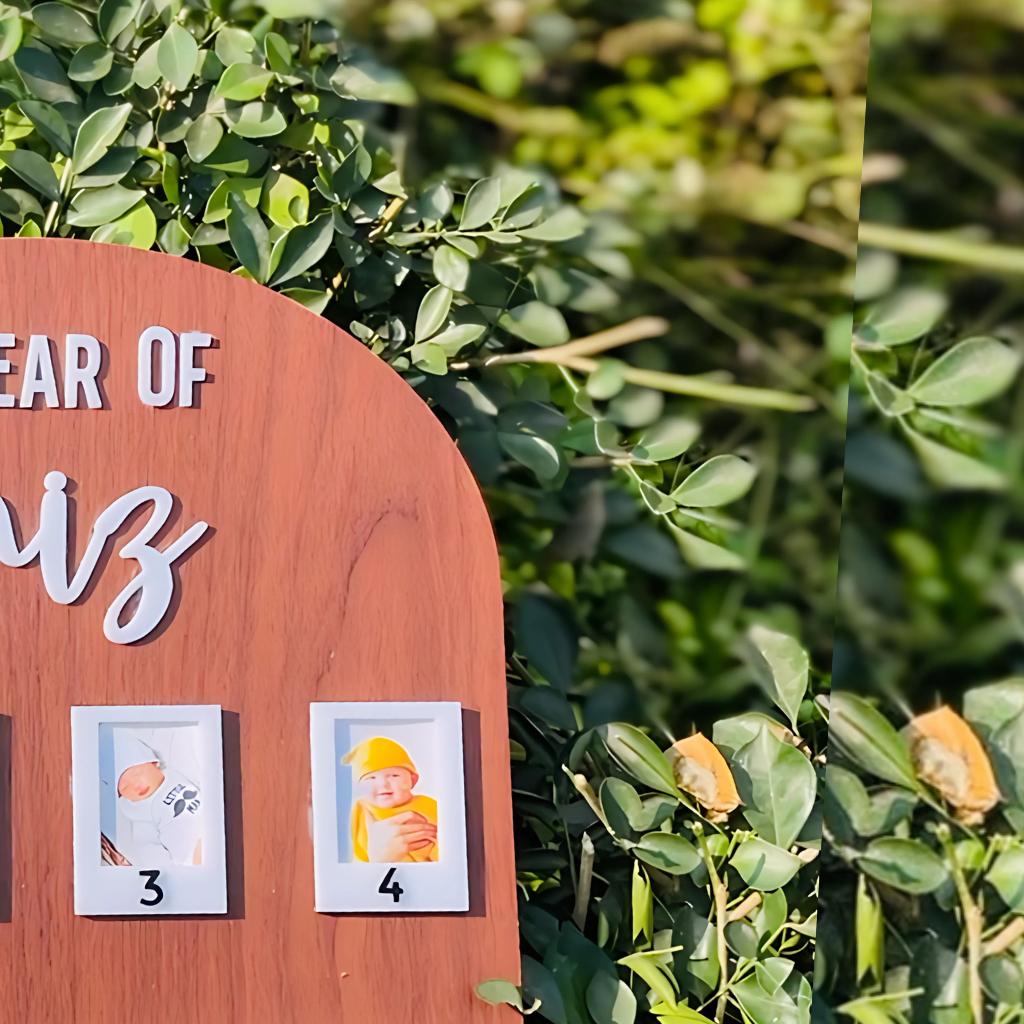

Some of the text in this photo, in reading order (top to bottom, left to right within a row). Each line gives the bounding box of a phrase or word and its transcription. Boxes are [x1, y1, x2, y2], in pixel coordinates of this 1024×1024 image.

[137, 326, 212, 408] OF
[139, 870, 164, 906] 3
[378, 867, 404, 903] 4
